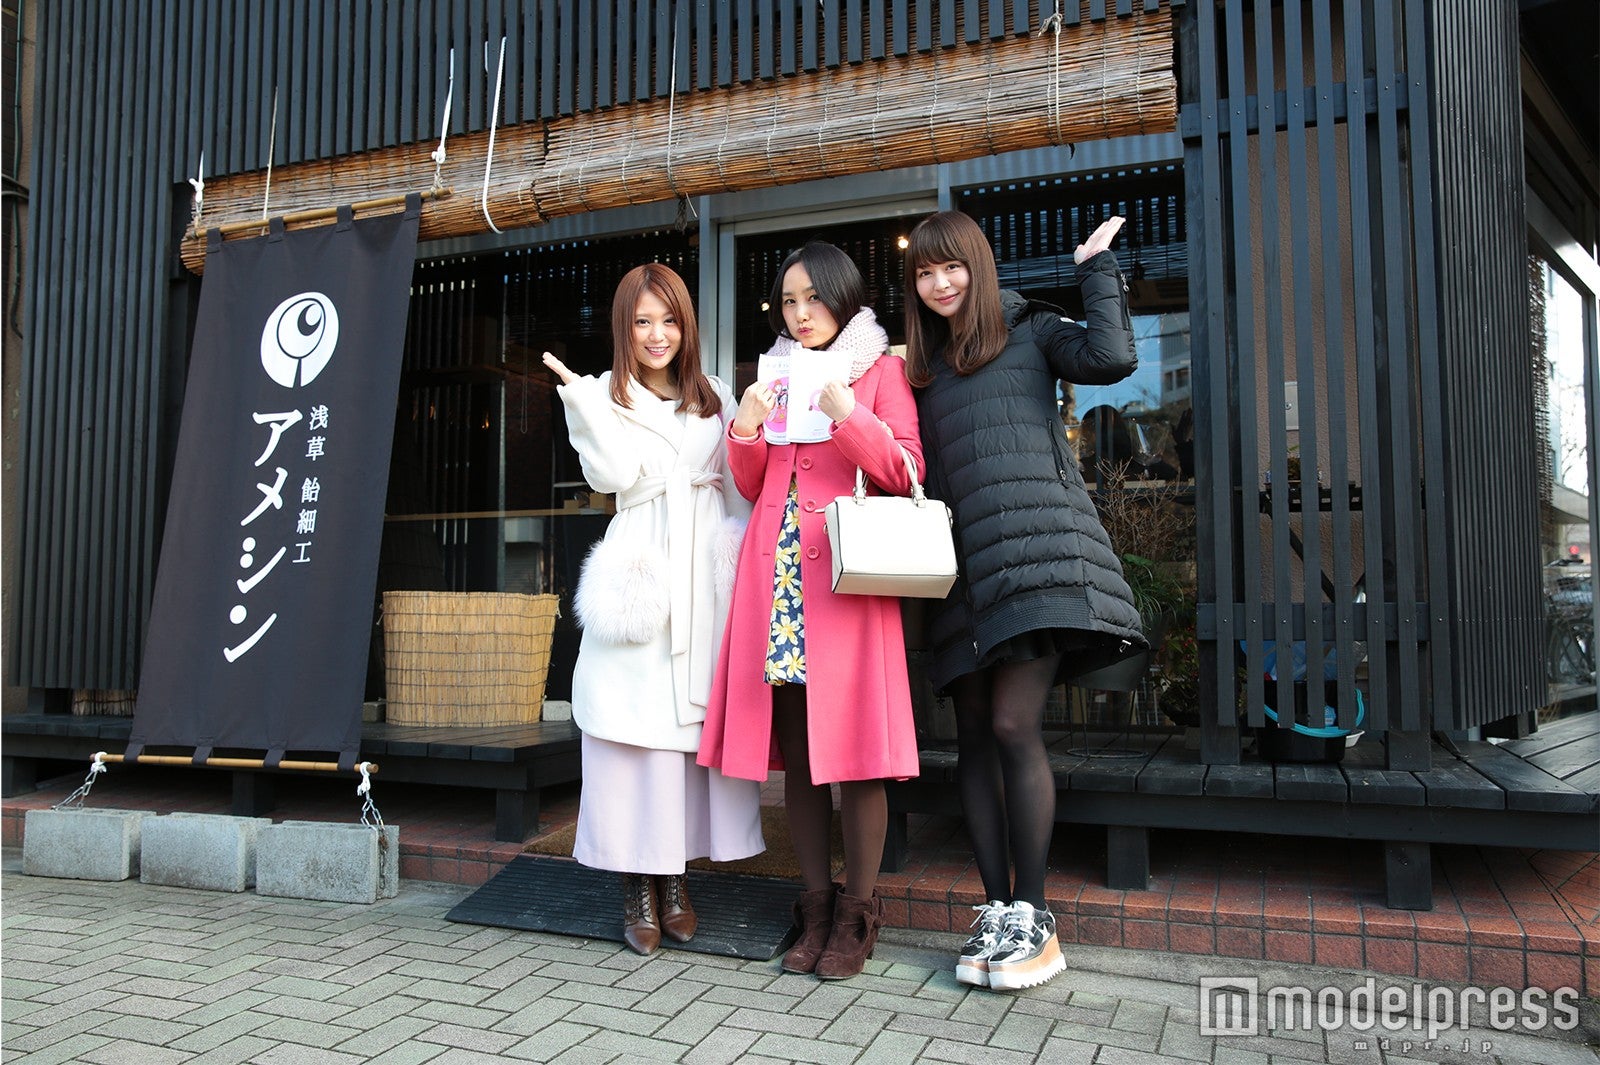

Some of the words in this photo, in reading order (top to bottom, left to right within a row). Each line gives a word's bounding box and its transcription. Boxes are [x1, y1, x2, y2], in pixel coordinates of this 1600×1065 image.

[305, 404, 329, 461] 浅草
[223, 409, 302, 663] アメシン
[292, 477, 320, 563] 飴細工
